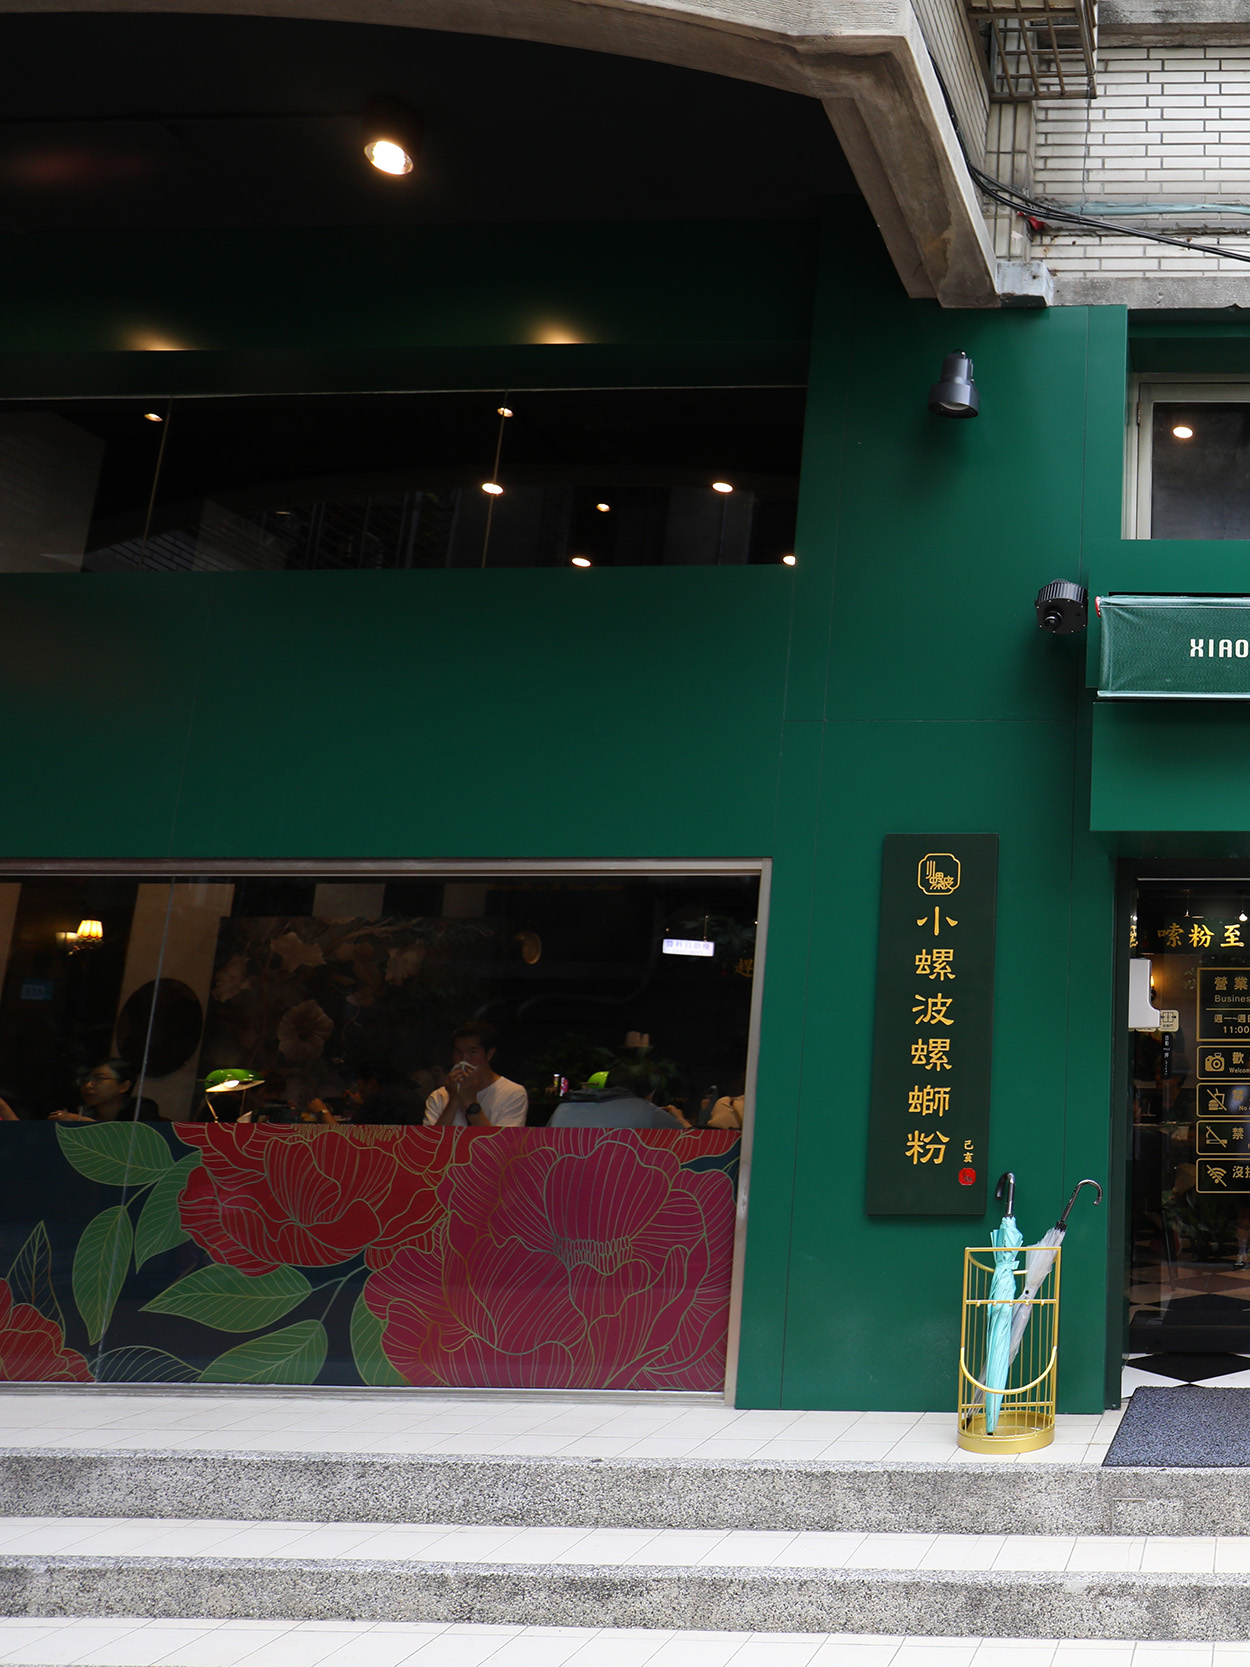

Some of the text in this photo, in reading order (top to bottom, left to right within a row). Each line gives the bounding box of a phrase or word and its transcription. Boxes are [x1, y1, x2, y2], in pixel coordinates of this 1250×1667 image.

[1190, 638, 1249, 658] XIAO
[905, 905, 959, 1166] 小螺波螺螄粉
